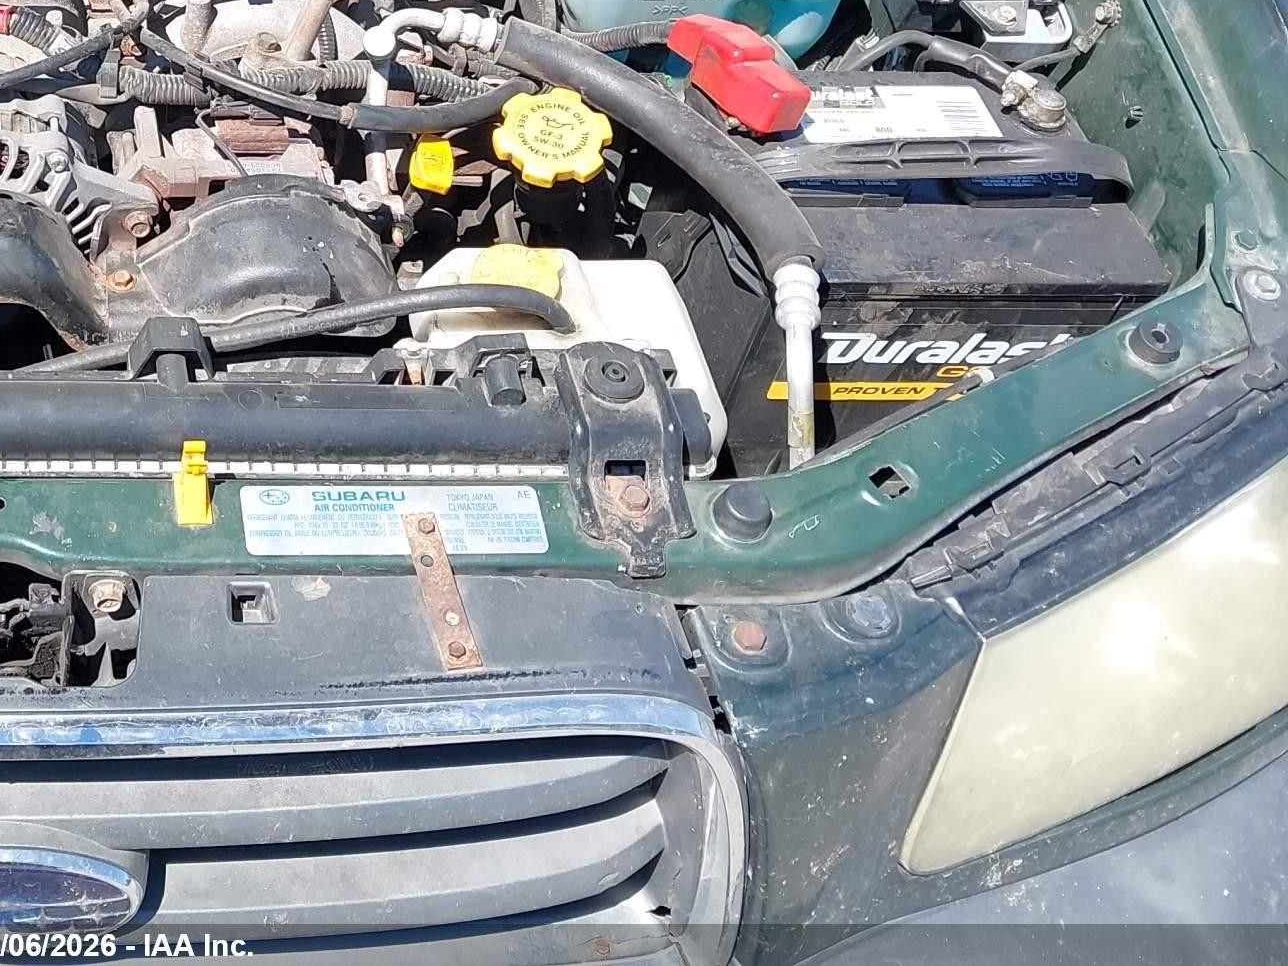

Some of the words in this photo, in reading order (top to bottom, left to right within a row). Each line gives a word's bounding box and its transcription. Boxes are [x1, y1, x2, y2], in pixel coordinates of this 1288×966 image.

[516, 113, 529, 130] SEE
[530, 102, 571, 113] ENGINE
[572, 112, 587, 126] OIL
[517, 132, 559, 160] OWNER'S
[562, 131, 590, 159] MANUAL
[832, 386, 926, 396] PROVEN
[311, 490, 406, 502] SUBARU
[446, 493, 470, 501] TOKYO
[471, 493, 494, 501] JAPAN
[314, 503, 330, 512] AIR
[331, 503, 395, 512] CONDITIONER
[448, 502, 499, 511] CLIMATISEUR
